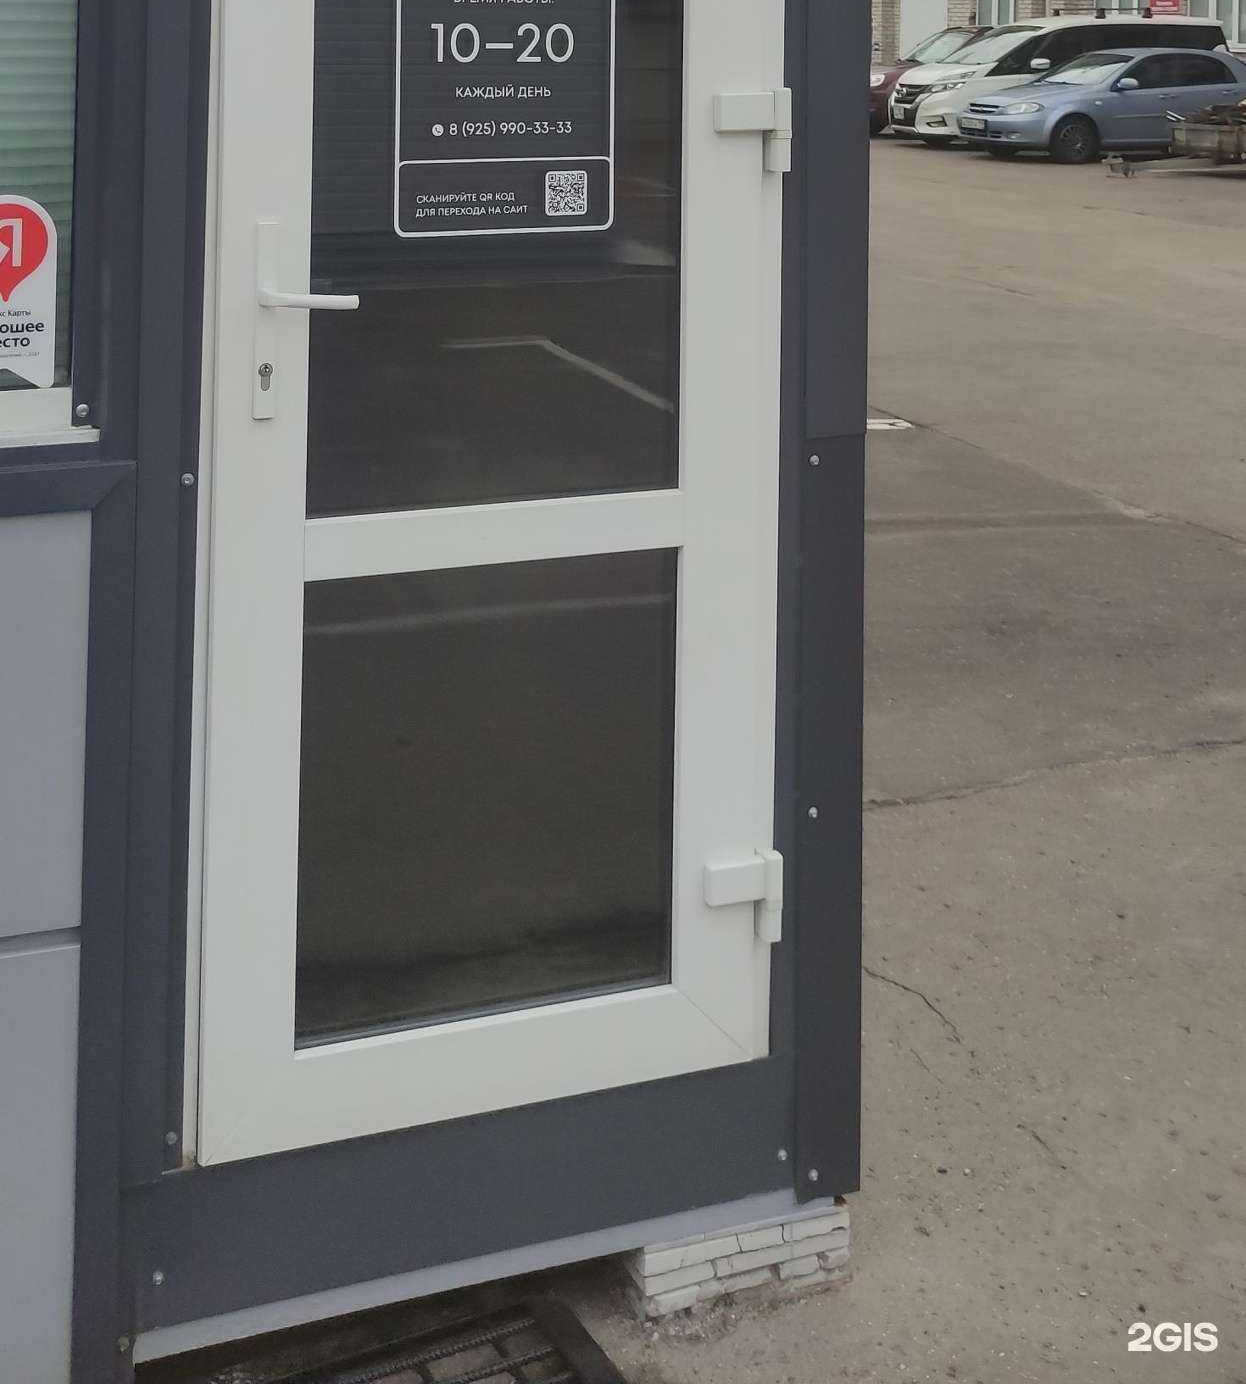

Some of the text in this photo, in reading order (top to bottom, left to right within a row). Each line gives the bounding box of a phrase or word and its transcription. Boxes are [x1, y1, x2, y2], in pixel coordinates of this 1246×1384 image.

[455, 84, 552, 99] КАЖДЫЙ ДЕНЬ
[449, 121, 573, 137] 8 (925) 990-33-33
[416, 192, 516, 204] СКАНИРУЙТЕ QR КОД
[415, 208, 436, 218] ДЛЯ
[438, 206, 487, 216] ПЕРЕХОДА
[488, 206, 502, 215] НА
